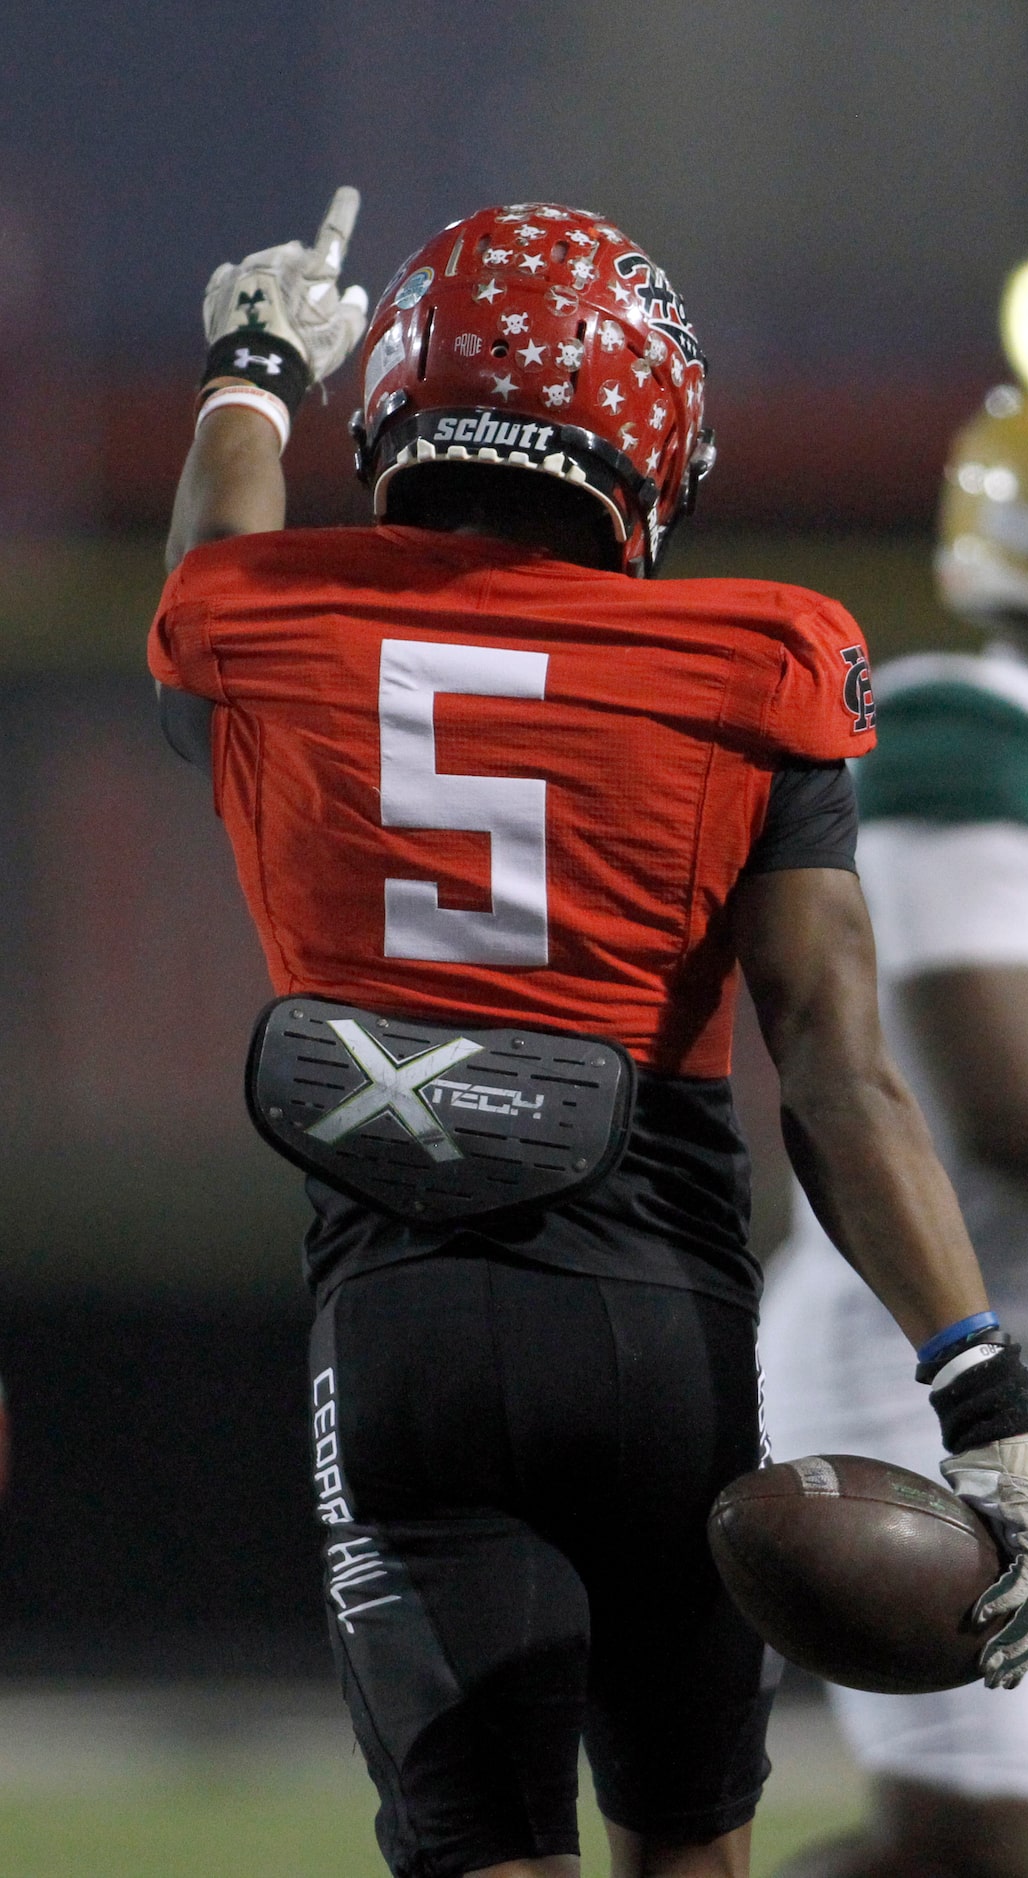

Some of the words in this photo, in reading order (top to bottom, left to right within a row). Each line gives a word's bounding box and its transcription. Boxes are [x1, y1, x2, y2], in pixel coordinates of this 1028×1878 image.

[453, 333, 483, 357] PRIDE
[433, 411, 554, 452] schutt
[378, 638, 549, 966] 5
[312, 1366, 354, 1525] CEDAR
[327, 1536, 402, 1635] HILL
